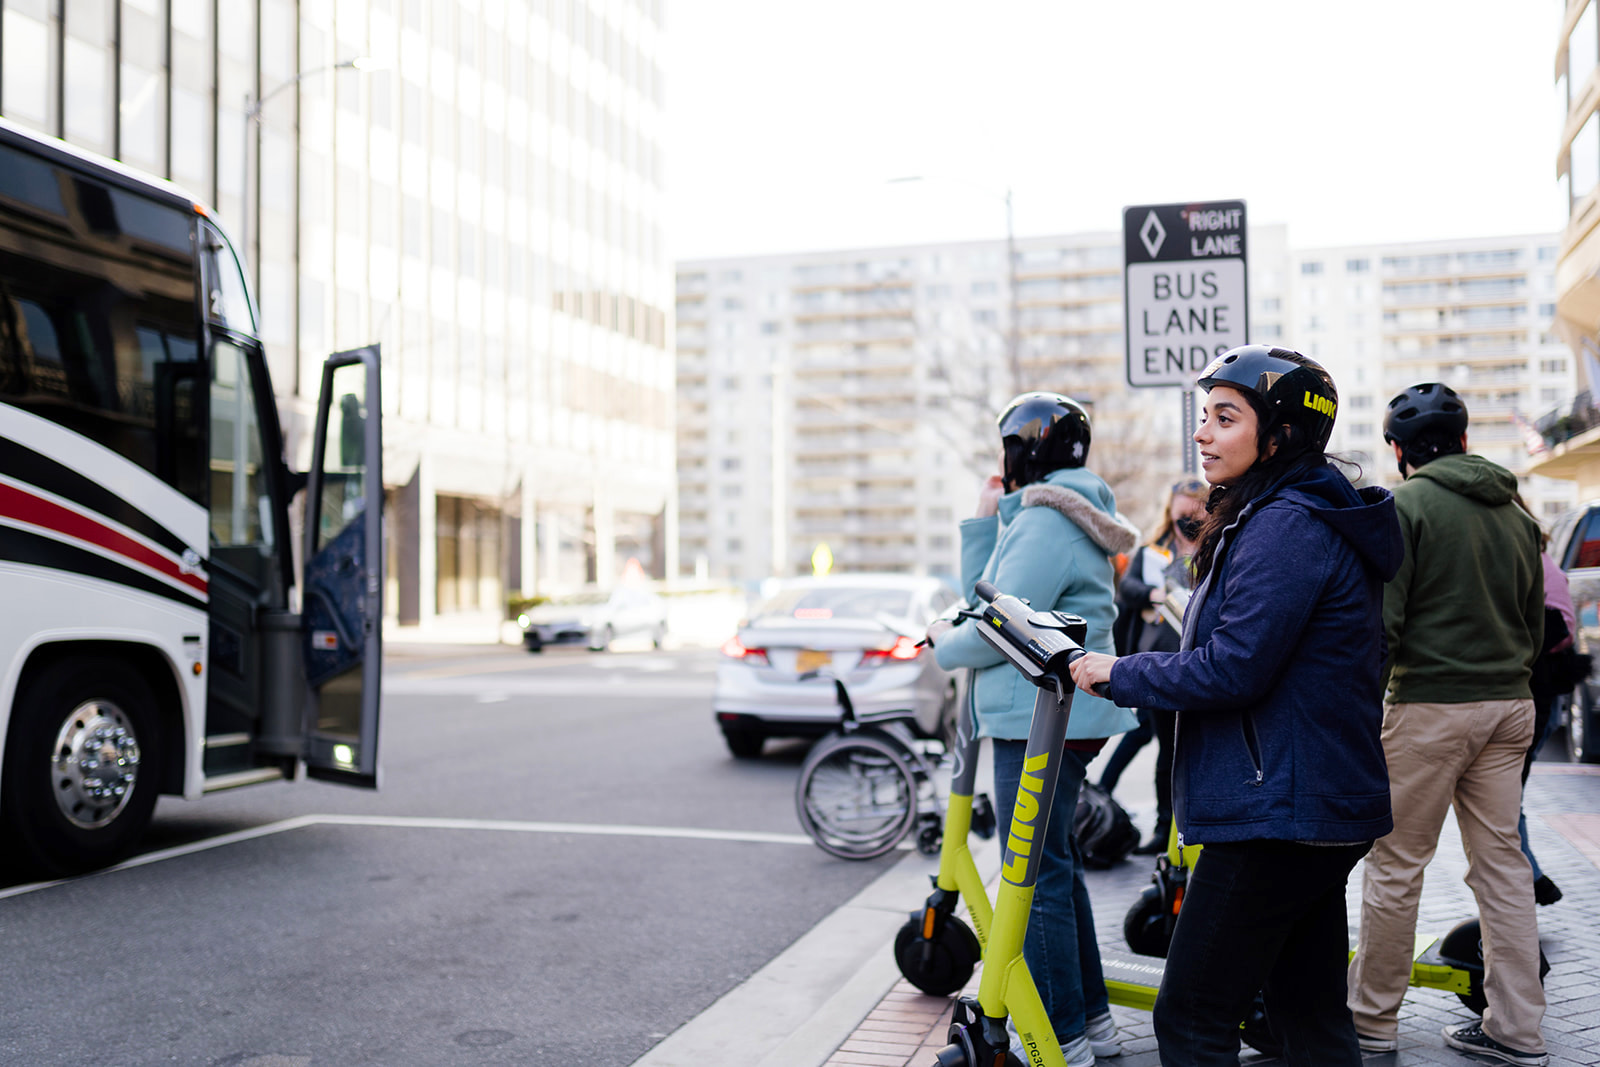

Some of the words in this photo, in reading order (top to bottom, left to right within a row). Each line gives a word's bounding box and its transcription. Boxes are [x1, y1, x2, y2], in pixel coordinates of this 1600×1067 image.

[1188, 209, 1243, 231] RIGHT
[1191, 234, 1242, 256] LANE
[1153, 272, 1219, 301] BUS
[1143, 306, 1231, 336] LANE
[1303, 390, 1337, 420] LINK
[1002, 751, 1050, 885] LINK
